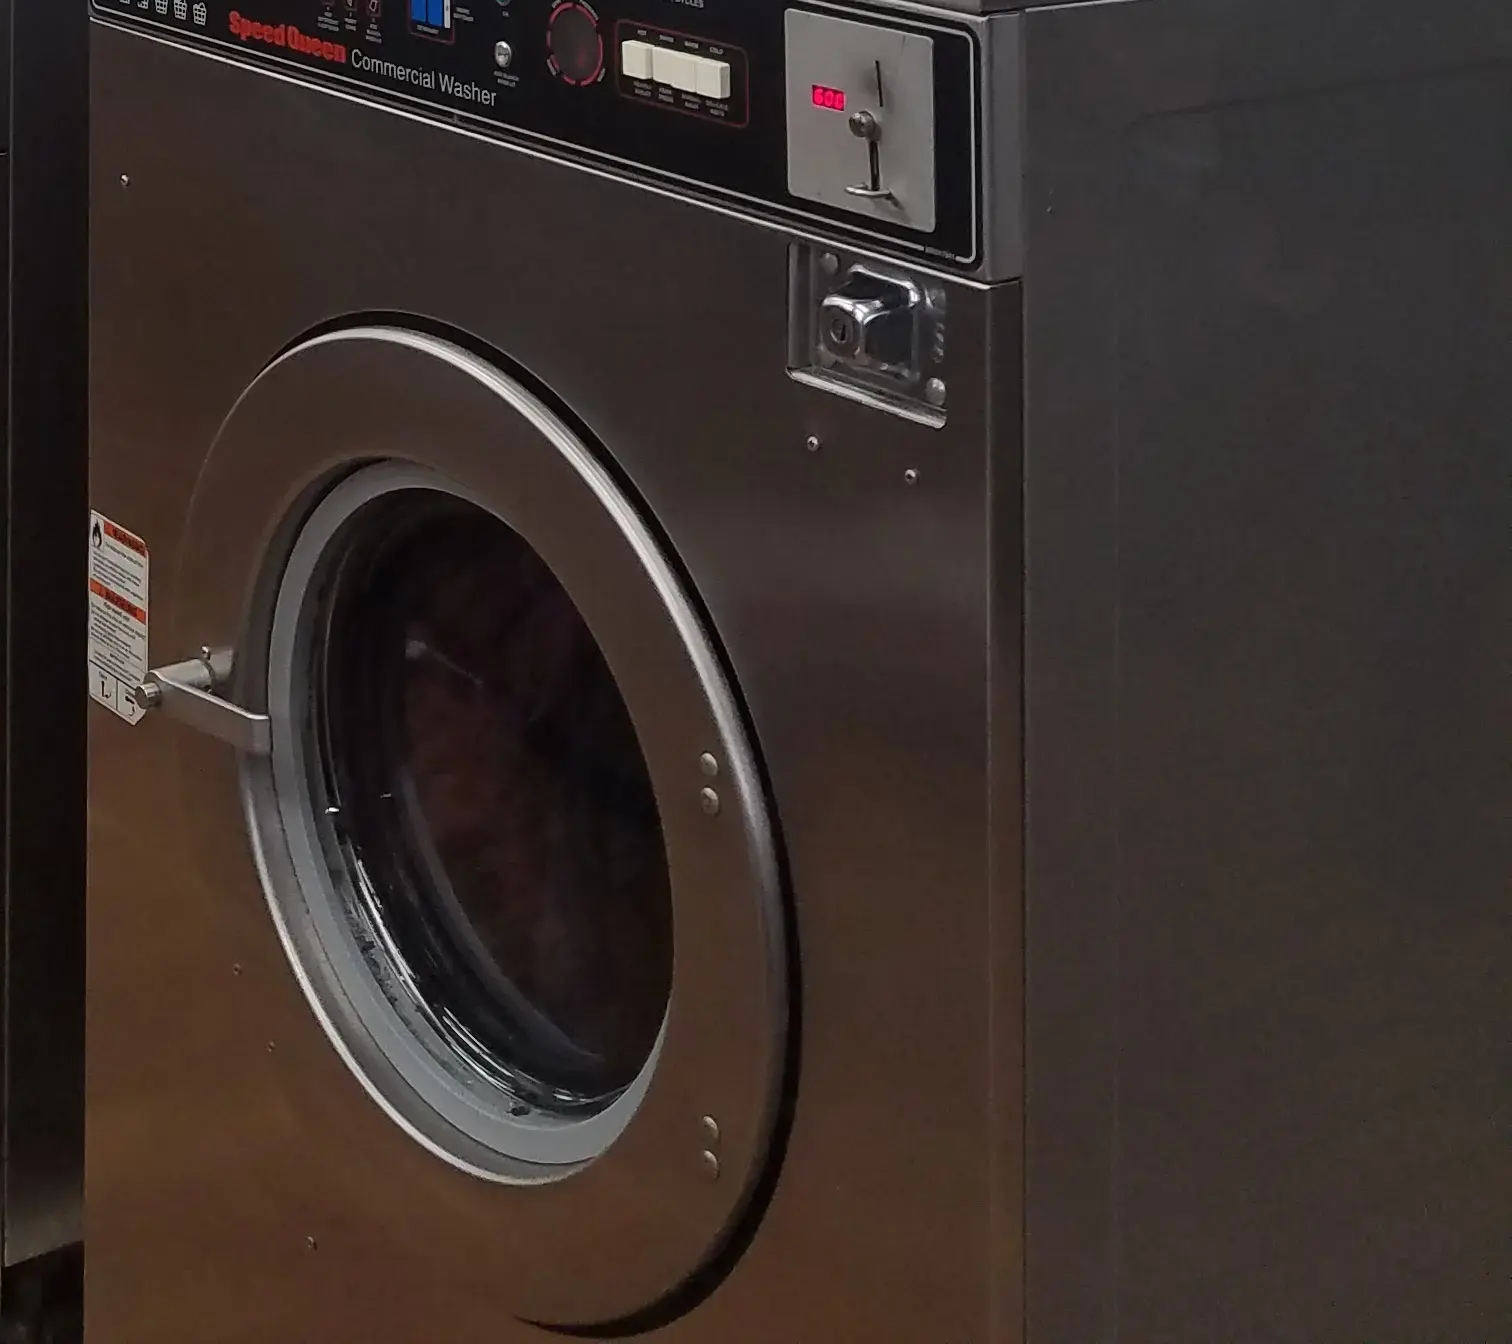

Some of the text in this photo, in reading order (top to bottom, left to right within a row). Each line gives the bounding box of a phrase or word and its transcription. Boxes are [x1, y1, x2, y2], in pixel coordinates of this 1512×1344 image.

[228, 10, 286, 48] Speed
[287, 23, 347, 64] Queen
[351, 48, 436, 90] Commercial
[438, 71, 497, 107] Washer
